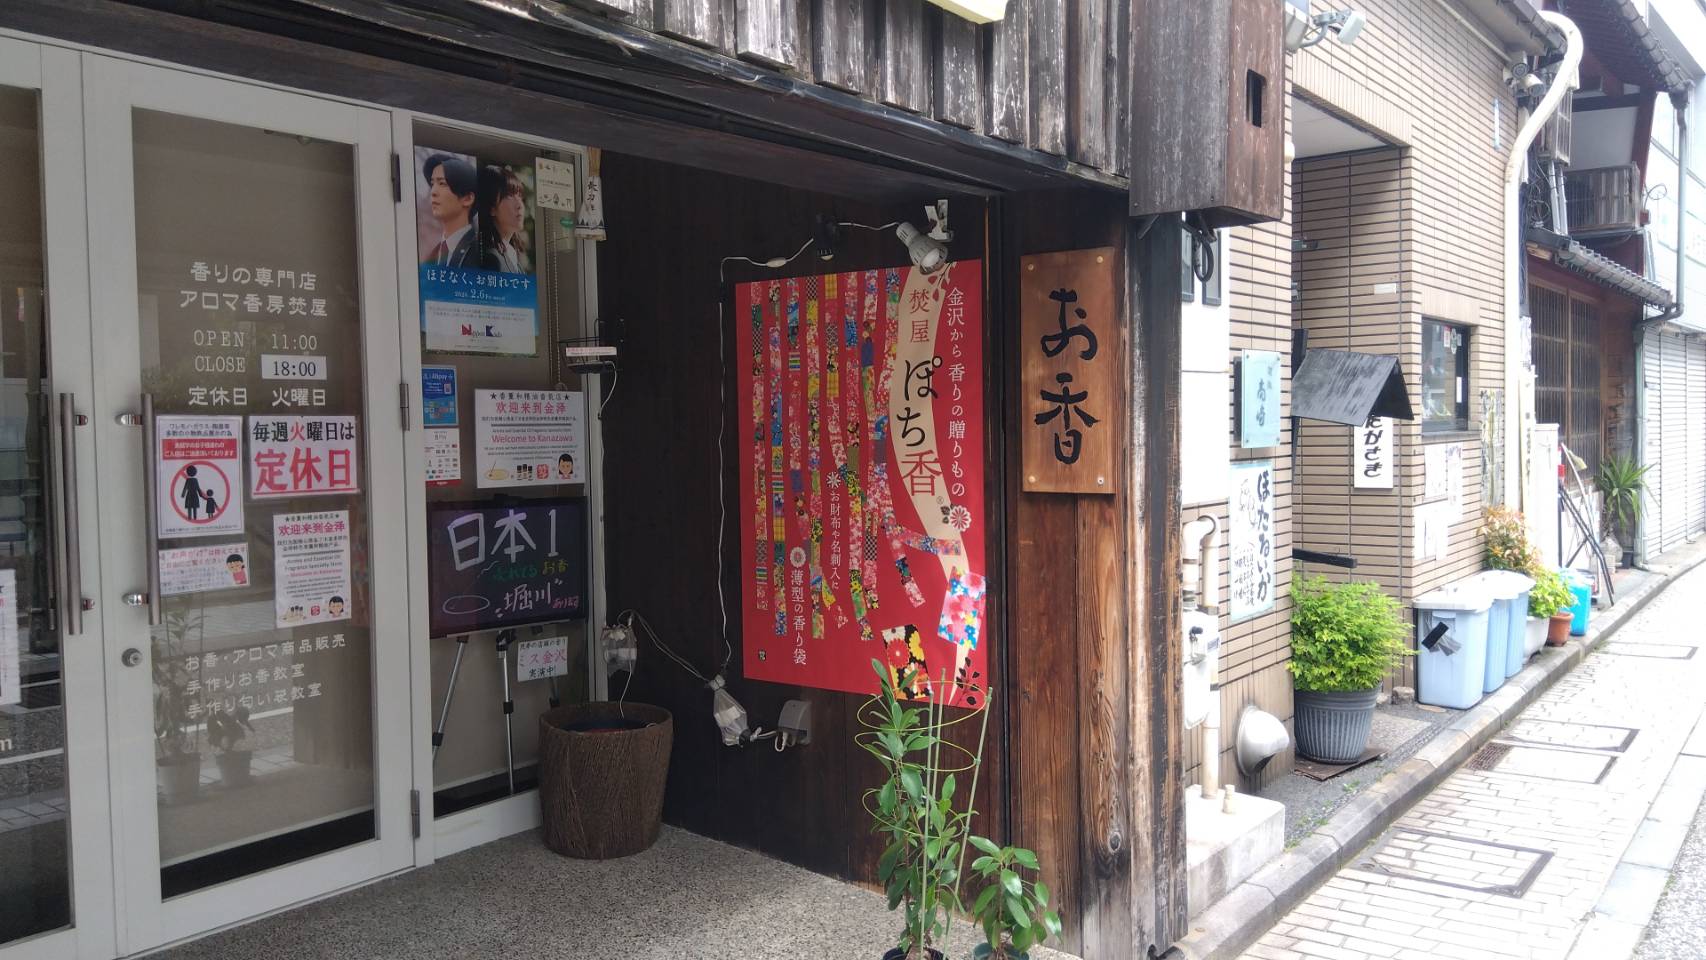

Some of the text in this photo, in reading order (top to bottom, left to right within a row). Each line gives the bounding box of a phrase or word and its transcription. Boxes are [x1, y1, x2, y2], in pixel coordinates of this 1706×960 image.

[190, 261, 317, 291] 香りの専門店
[426, 269, 531, 290] ほどなく、お別れです
[180, 290, 328, 317] アロマ香房焚屋
[193, 329, 318, 351] OPEN 11:00
[194, 355, 317, 377] CLOSE 18:00
[1034, 288, 1101, 464] お香
[188, 386, 327, 407] 定休日 火曜日
[897, 288, 943, 496] 焚屋 ぽち香
[947, 287, 966, 496] 金沢から香りの贈りもの
[253, 421, 355, 442] 毎週火曜日は
[491, 435, 527, 443] Welcome
[255, 446, 351, 492] 定休日
[447, 509, 559, 571] 日本1
[829, 491, 842, 590] お財布や名刺入に
[1257, 469, 1272, 602] ほたるいか
[790, 569, 807, 665] 薄型の香り袋
[185, 633, 346, 671] お香・アロマ商品販売
[186, 663, 305, 695] 手作りお香教室
